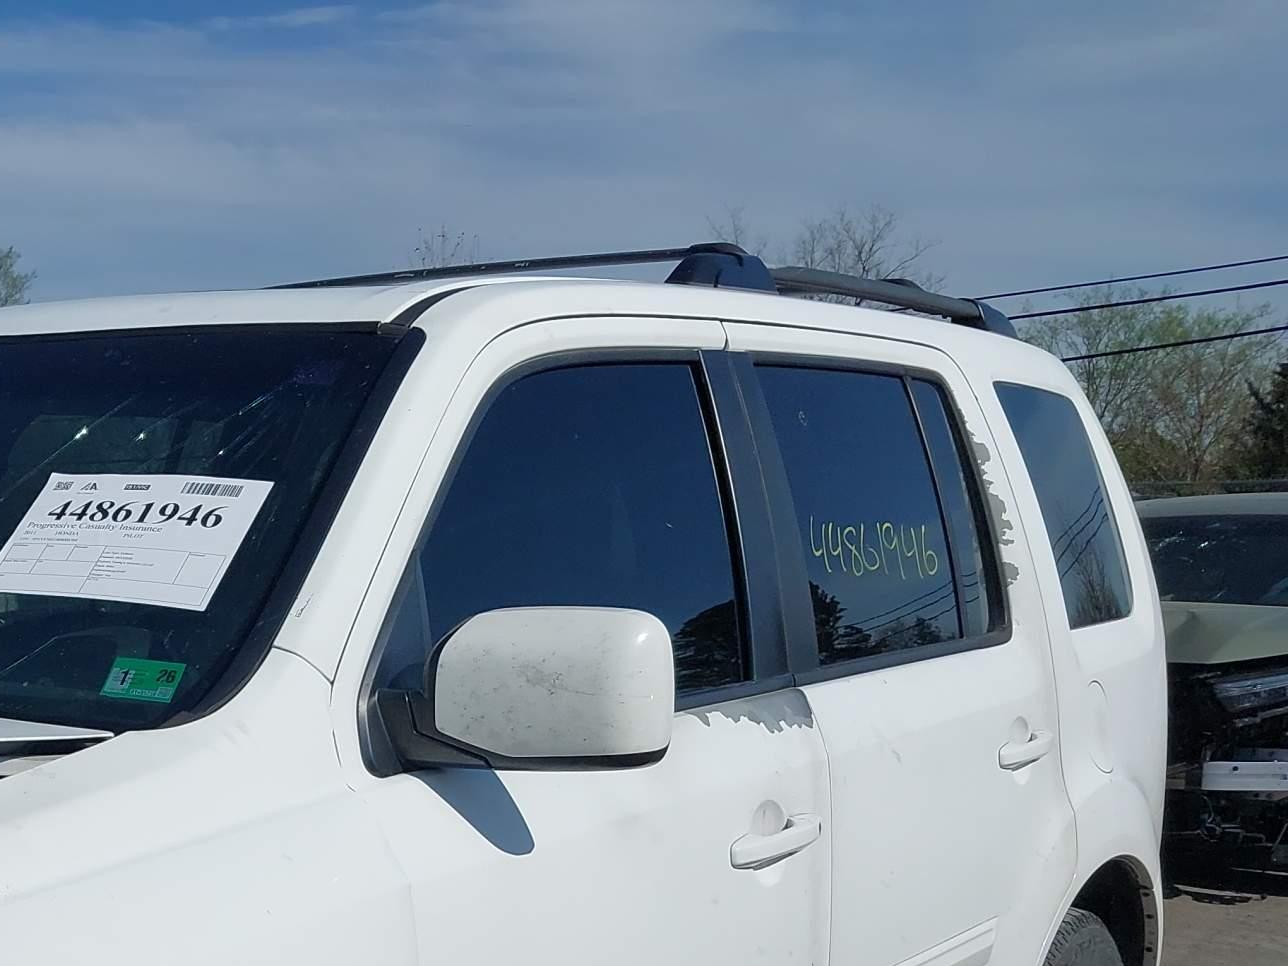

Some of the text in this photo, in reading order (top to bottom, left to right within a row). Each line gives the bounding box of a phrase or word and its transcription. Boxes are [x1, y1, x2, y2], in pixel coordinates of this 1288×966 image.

[47, 499, 229, 529] 44861946
[26, 520, 163, 533] Progressive Casualty Insurance
[810, 515, 938, 579] 44861946
[156, 669, 176, 683] 26
